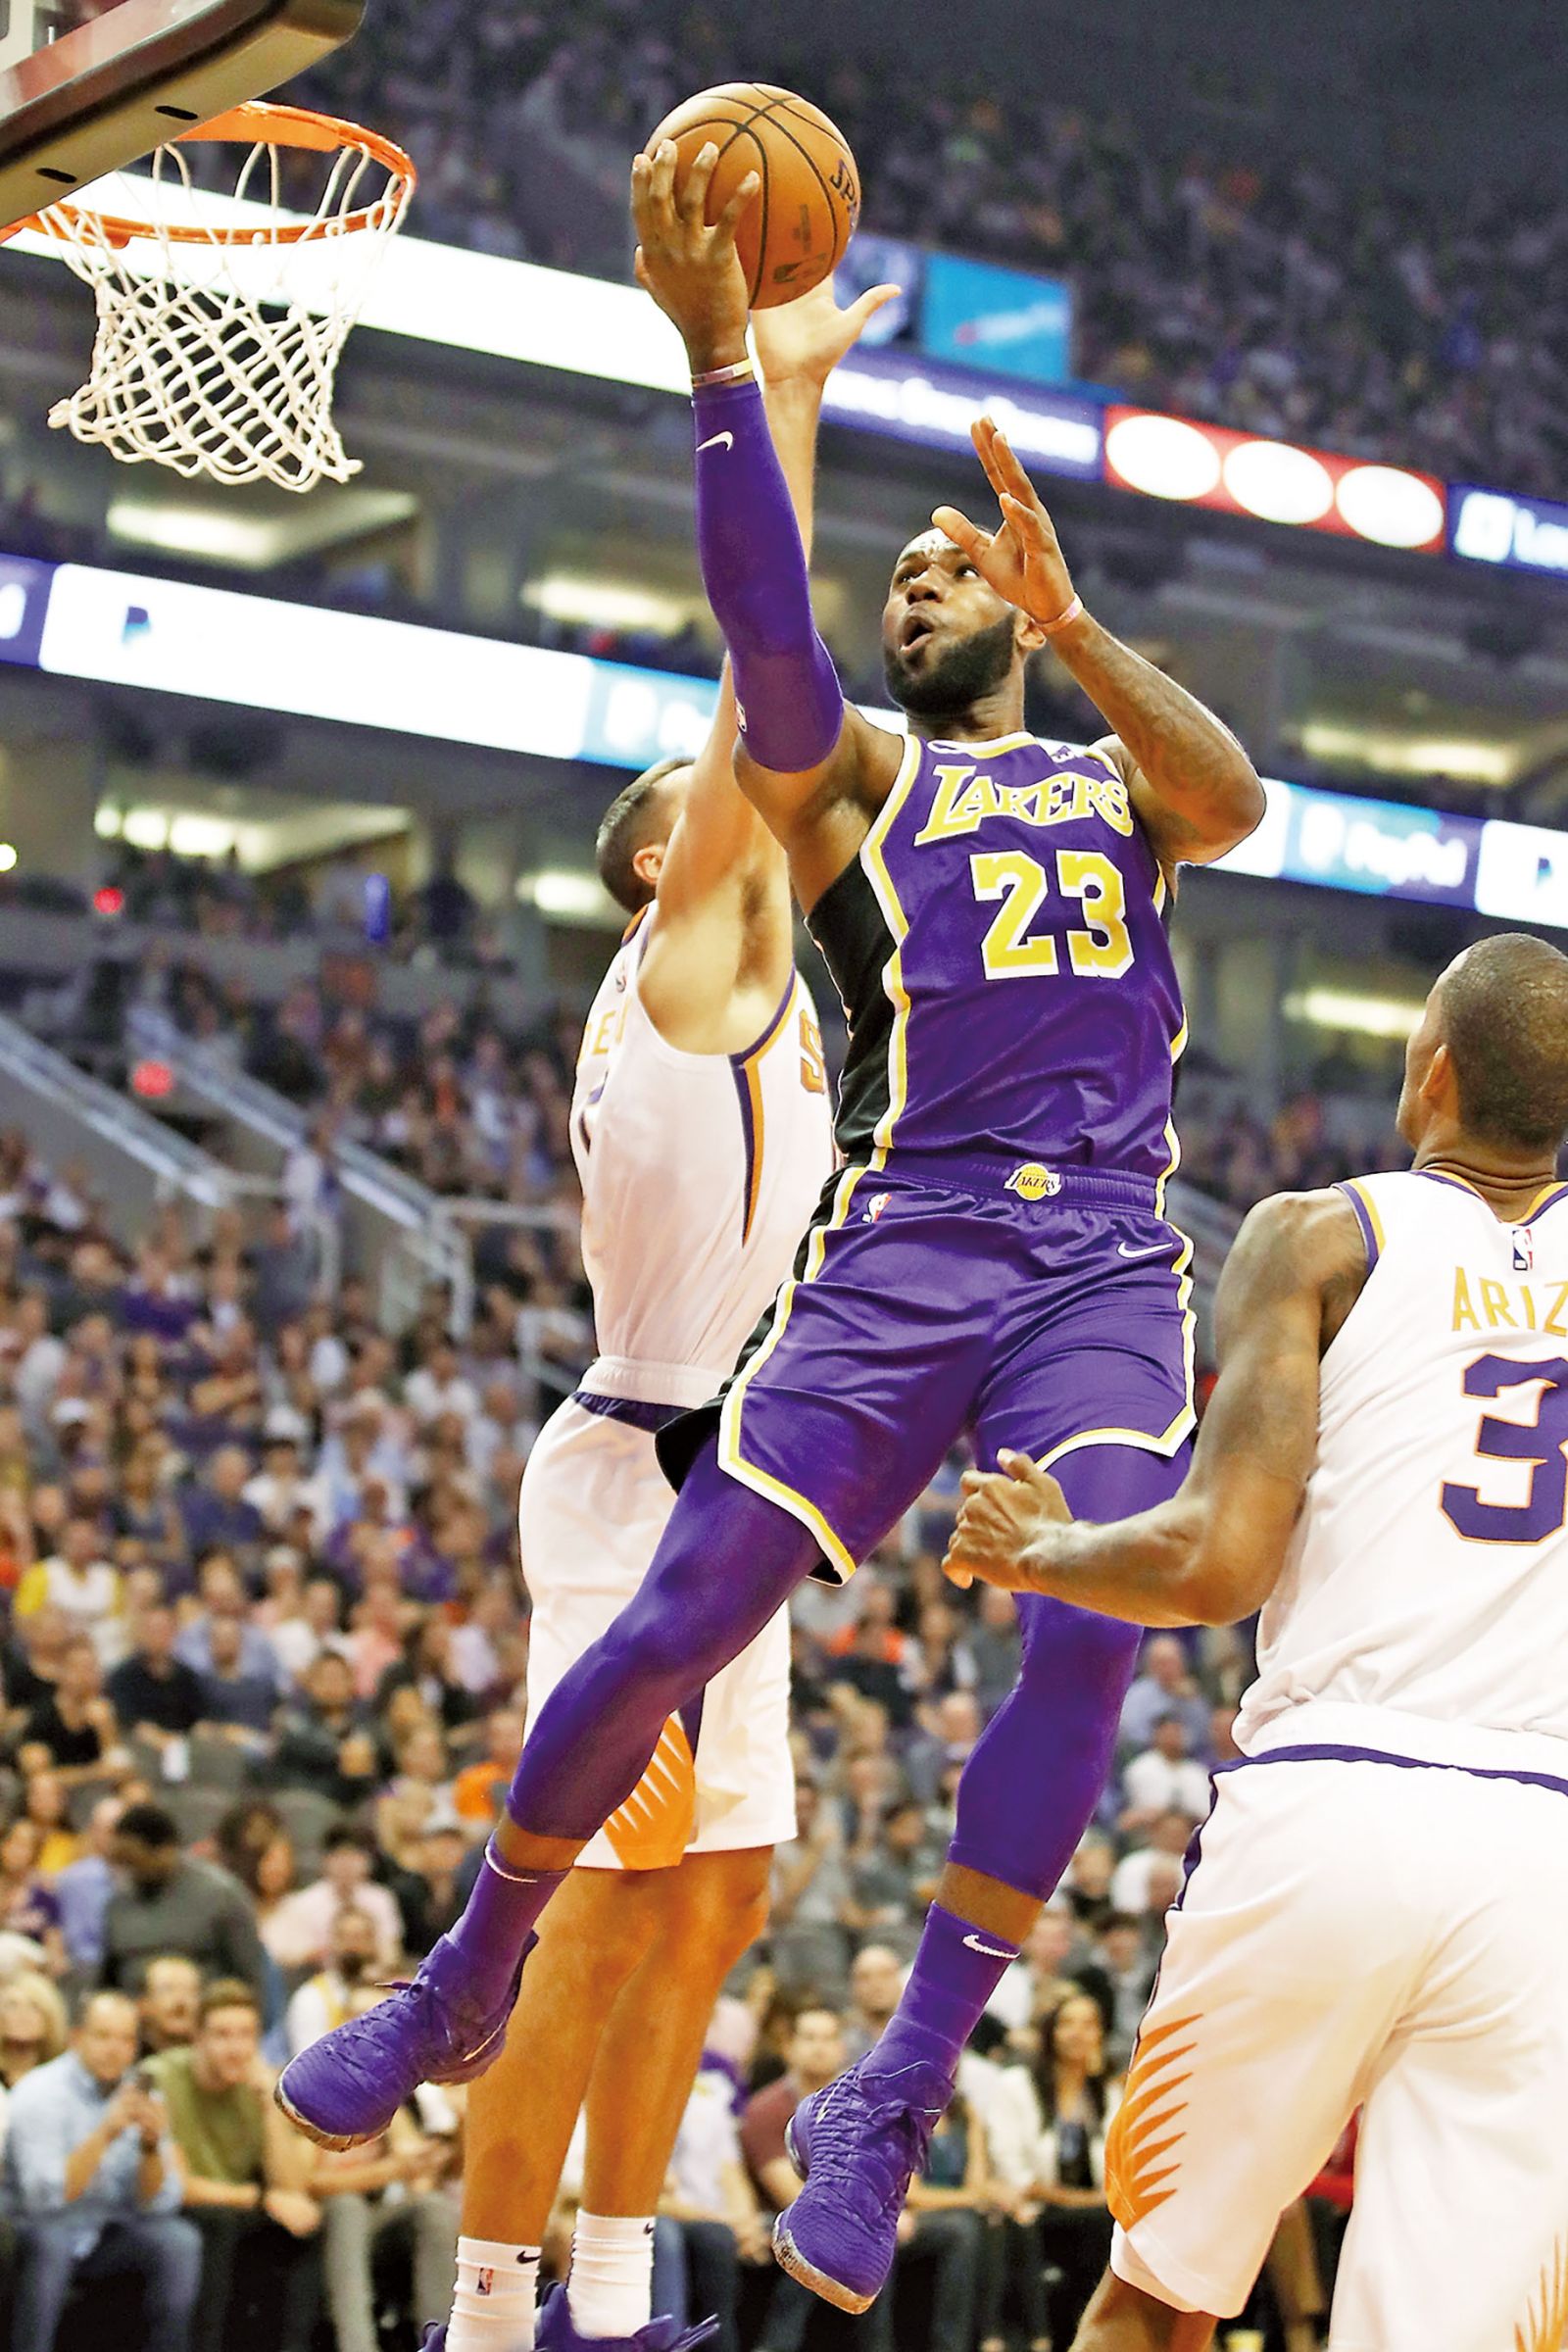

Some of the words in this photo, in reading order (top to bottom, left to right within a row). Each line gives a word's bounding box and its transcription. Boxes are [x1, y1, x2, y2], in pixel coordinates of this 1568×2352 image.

[913, 764, 1134, 847] LAKERS
[969, 850, 1135, 981] 23
[1004, 1168, 1062, 1197] LAKERS
[1450, 1265, 1568, 1338] ARIZ
[1438, 1349, 1568, 1545] 3
